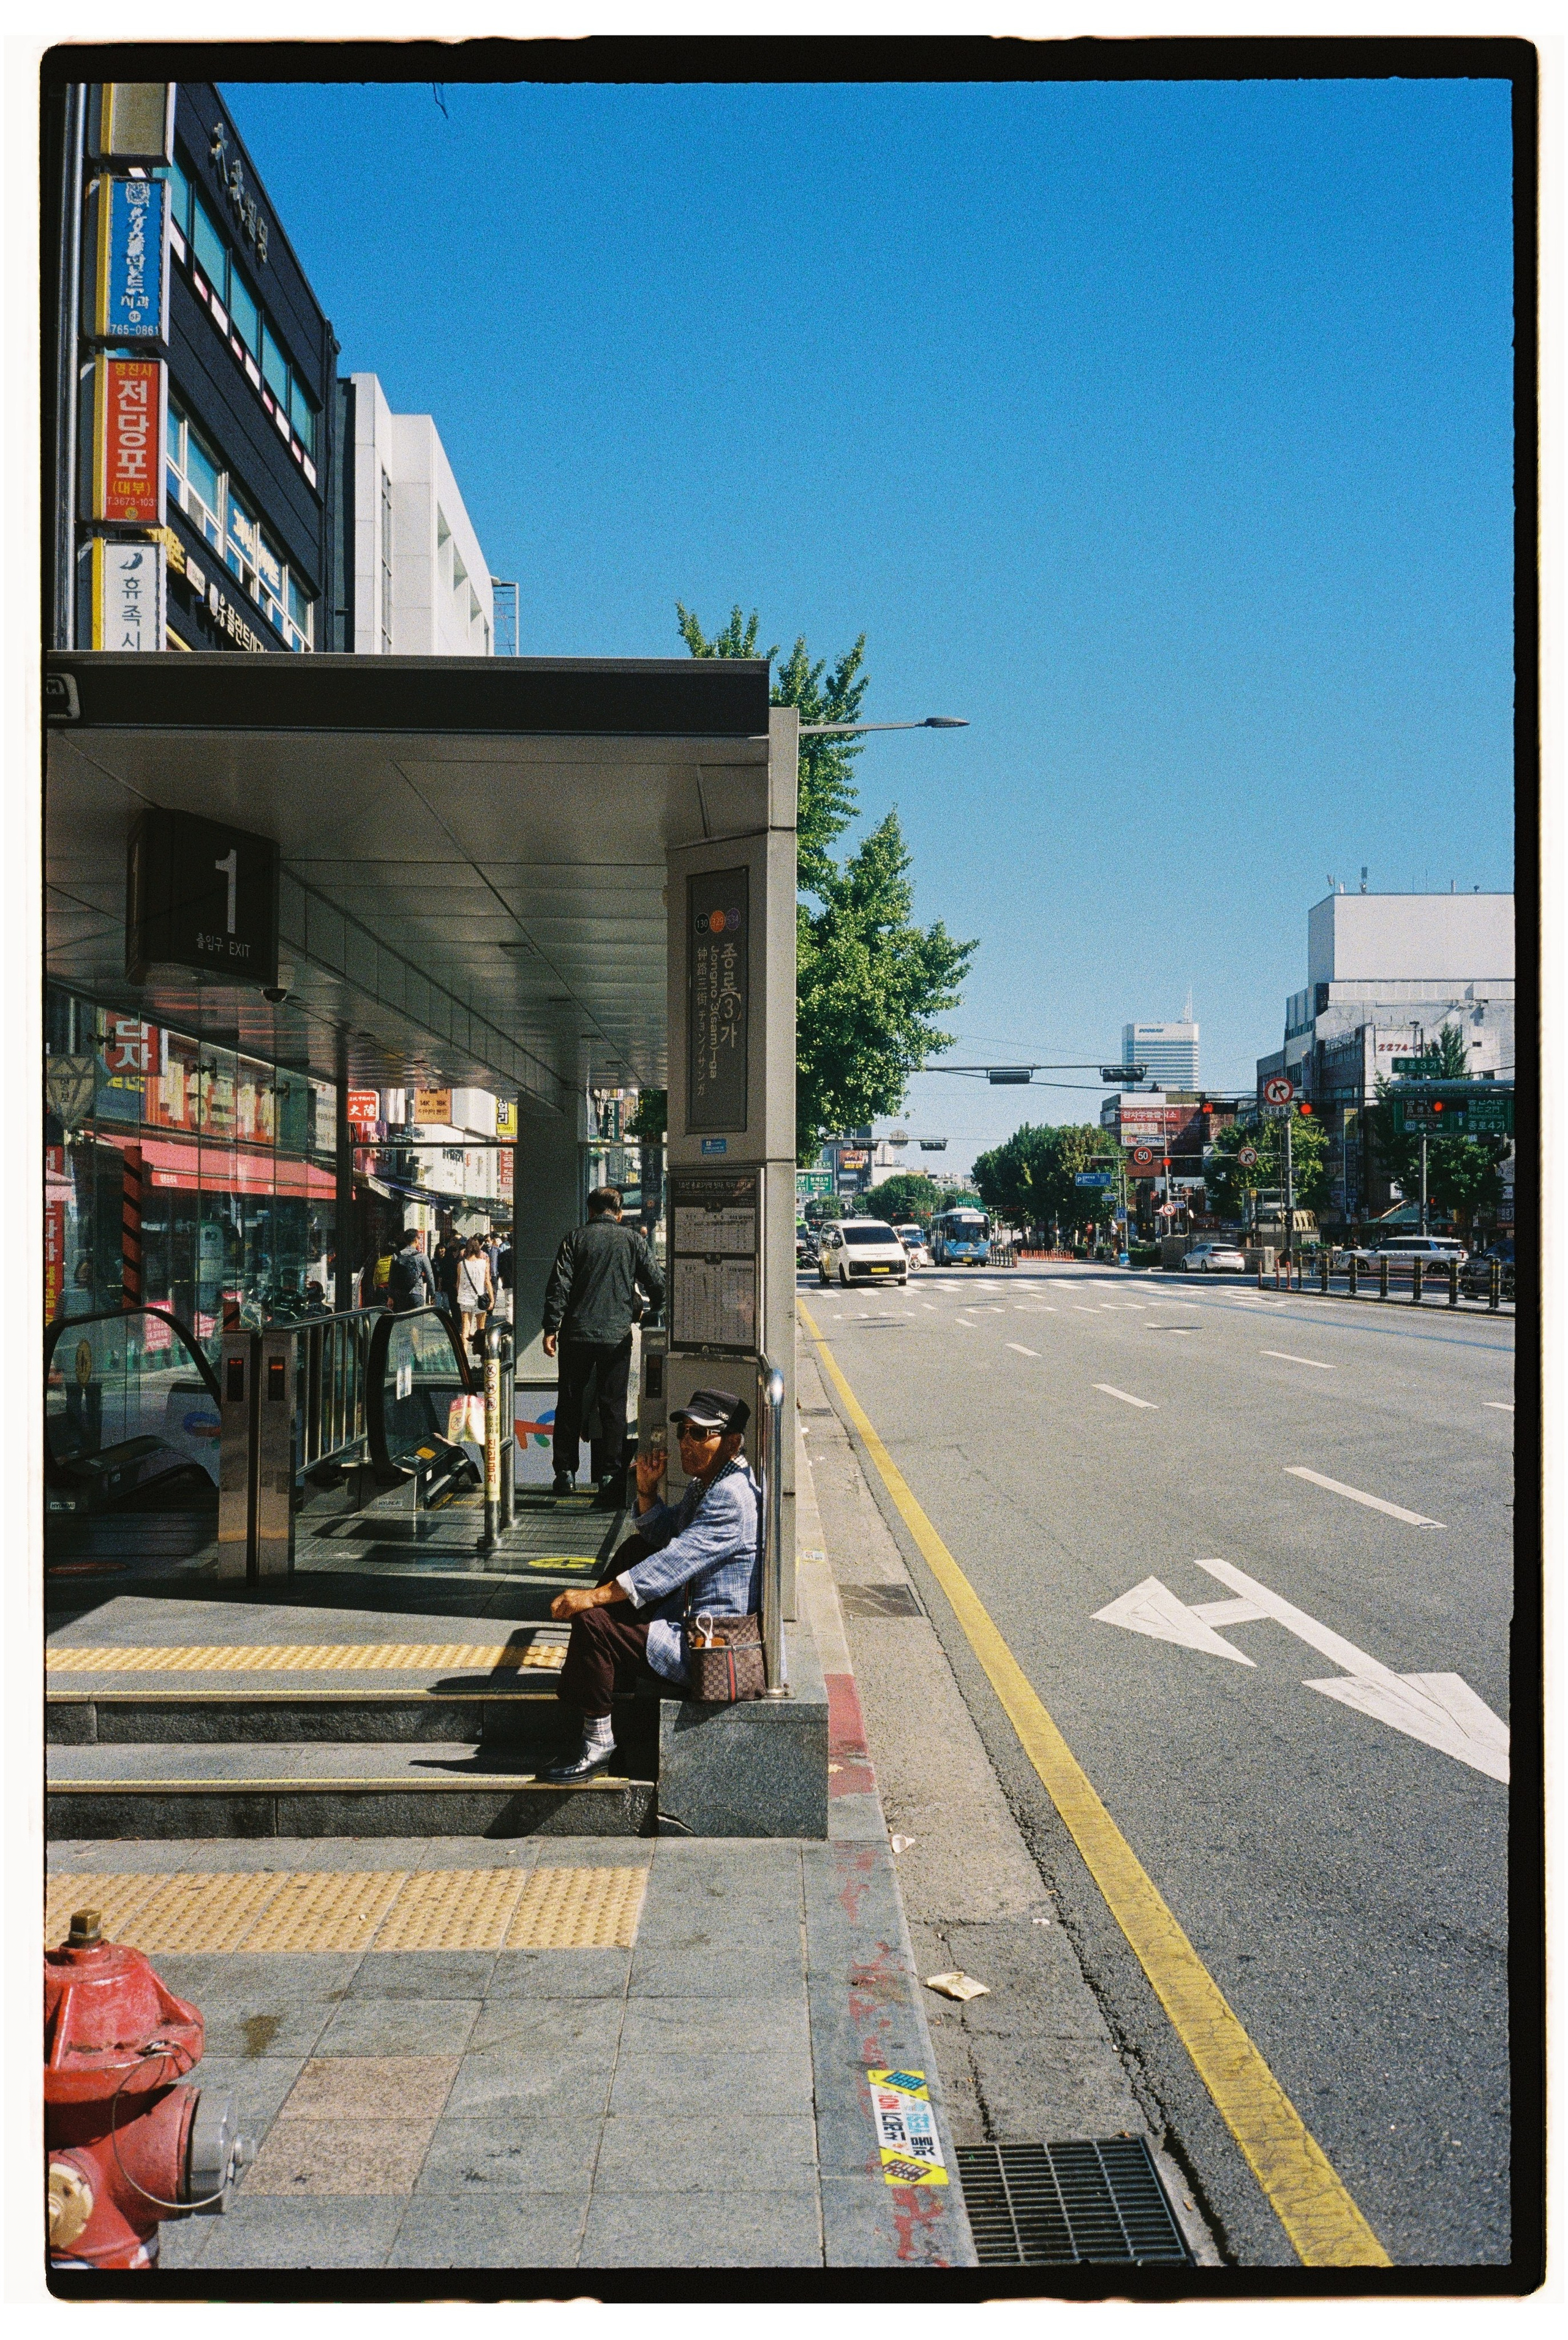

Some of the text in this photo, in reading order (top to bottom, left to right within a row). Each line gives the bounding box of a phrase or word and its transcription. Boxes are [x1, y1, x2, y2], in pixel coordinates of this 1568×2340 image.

[111, 324, 159, 336] 765-0861
[116, 379, 150, 479] 전당포
[112, 481, 151, 496] (대부)
[215, 849, 238, 934] 1
[696, 919, 708, 929] 130
[196, 932, 251, 959] 출입구 EXIT
[709, 945, 720, 1078] Jongno 3(sam)-ga
[1397, 1060, 1437, 1070] 종로3가
[349, 1104, 376, 1117] 大陸
[497, 1098, 509, 1124] 얼리
[1468, 1120, 1506, 1130] 종로4가
[1138, 1151, 1148, 1160] 50
[715, 1410, 729, 1421] Jeep
[486, 1438, 497, 1484] 진입금지
[878, 2094, 907, 2142] 쓰레기 NO!
[910, 2136, 936, 2156] 빗물
